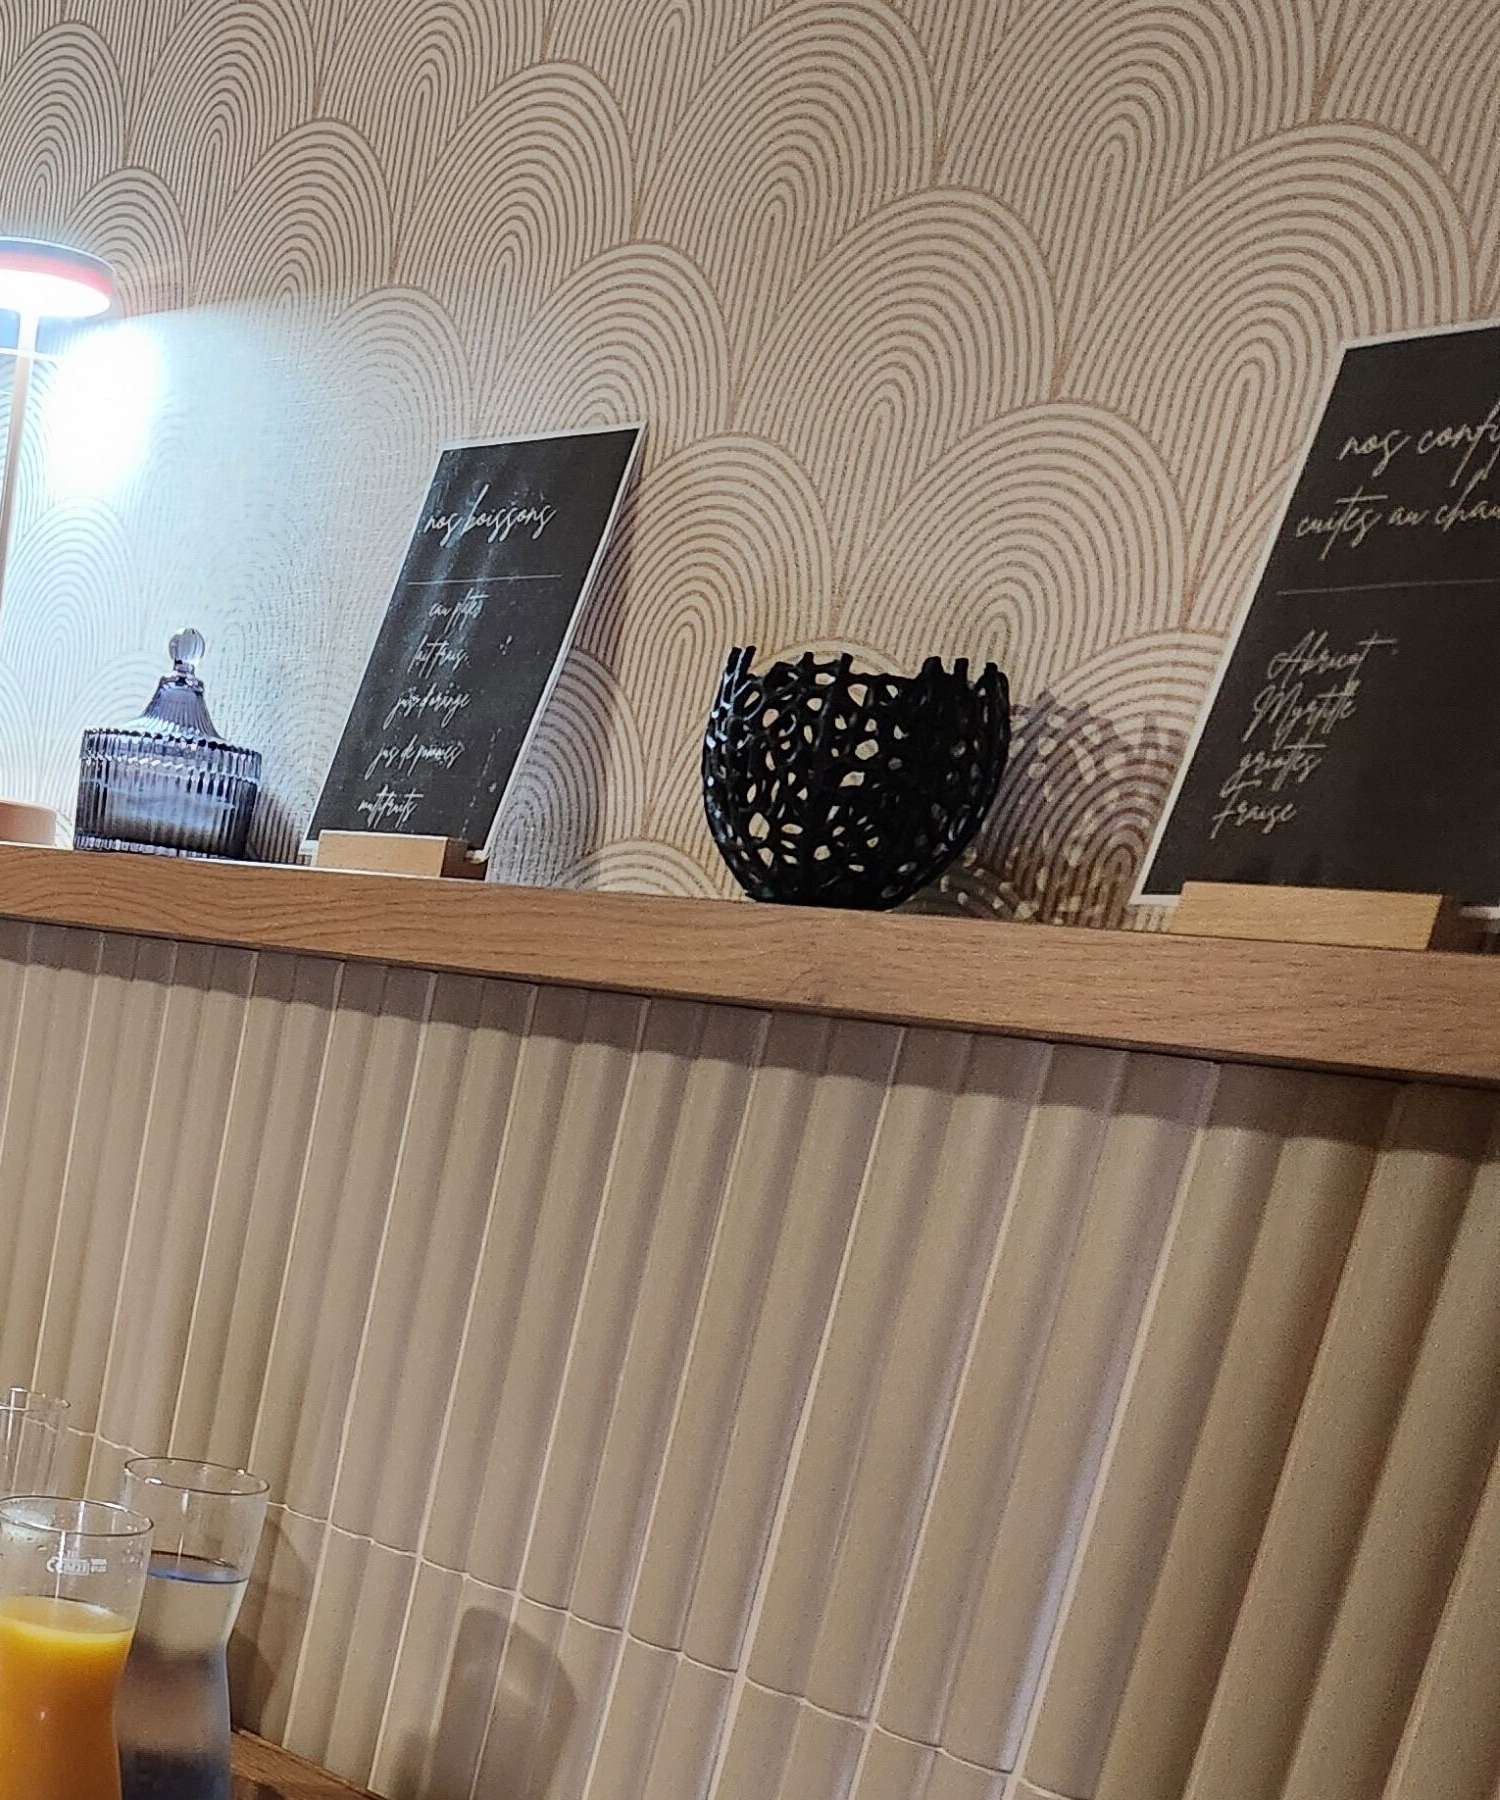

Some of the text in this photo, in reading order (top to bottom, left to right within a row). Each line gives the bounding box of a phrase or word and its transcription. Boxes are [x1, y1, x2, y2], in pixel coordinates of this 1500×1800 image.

[1337, 429, 1411, 480] nos
[423, 484, 558, 548] nos boissons
[1296, 484, 1389, 561] cuites
[1388, 506, 1431, 527] au
[1267, 629, 1398, 689] Abricot
[364, 744, 401, 781] jus
